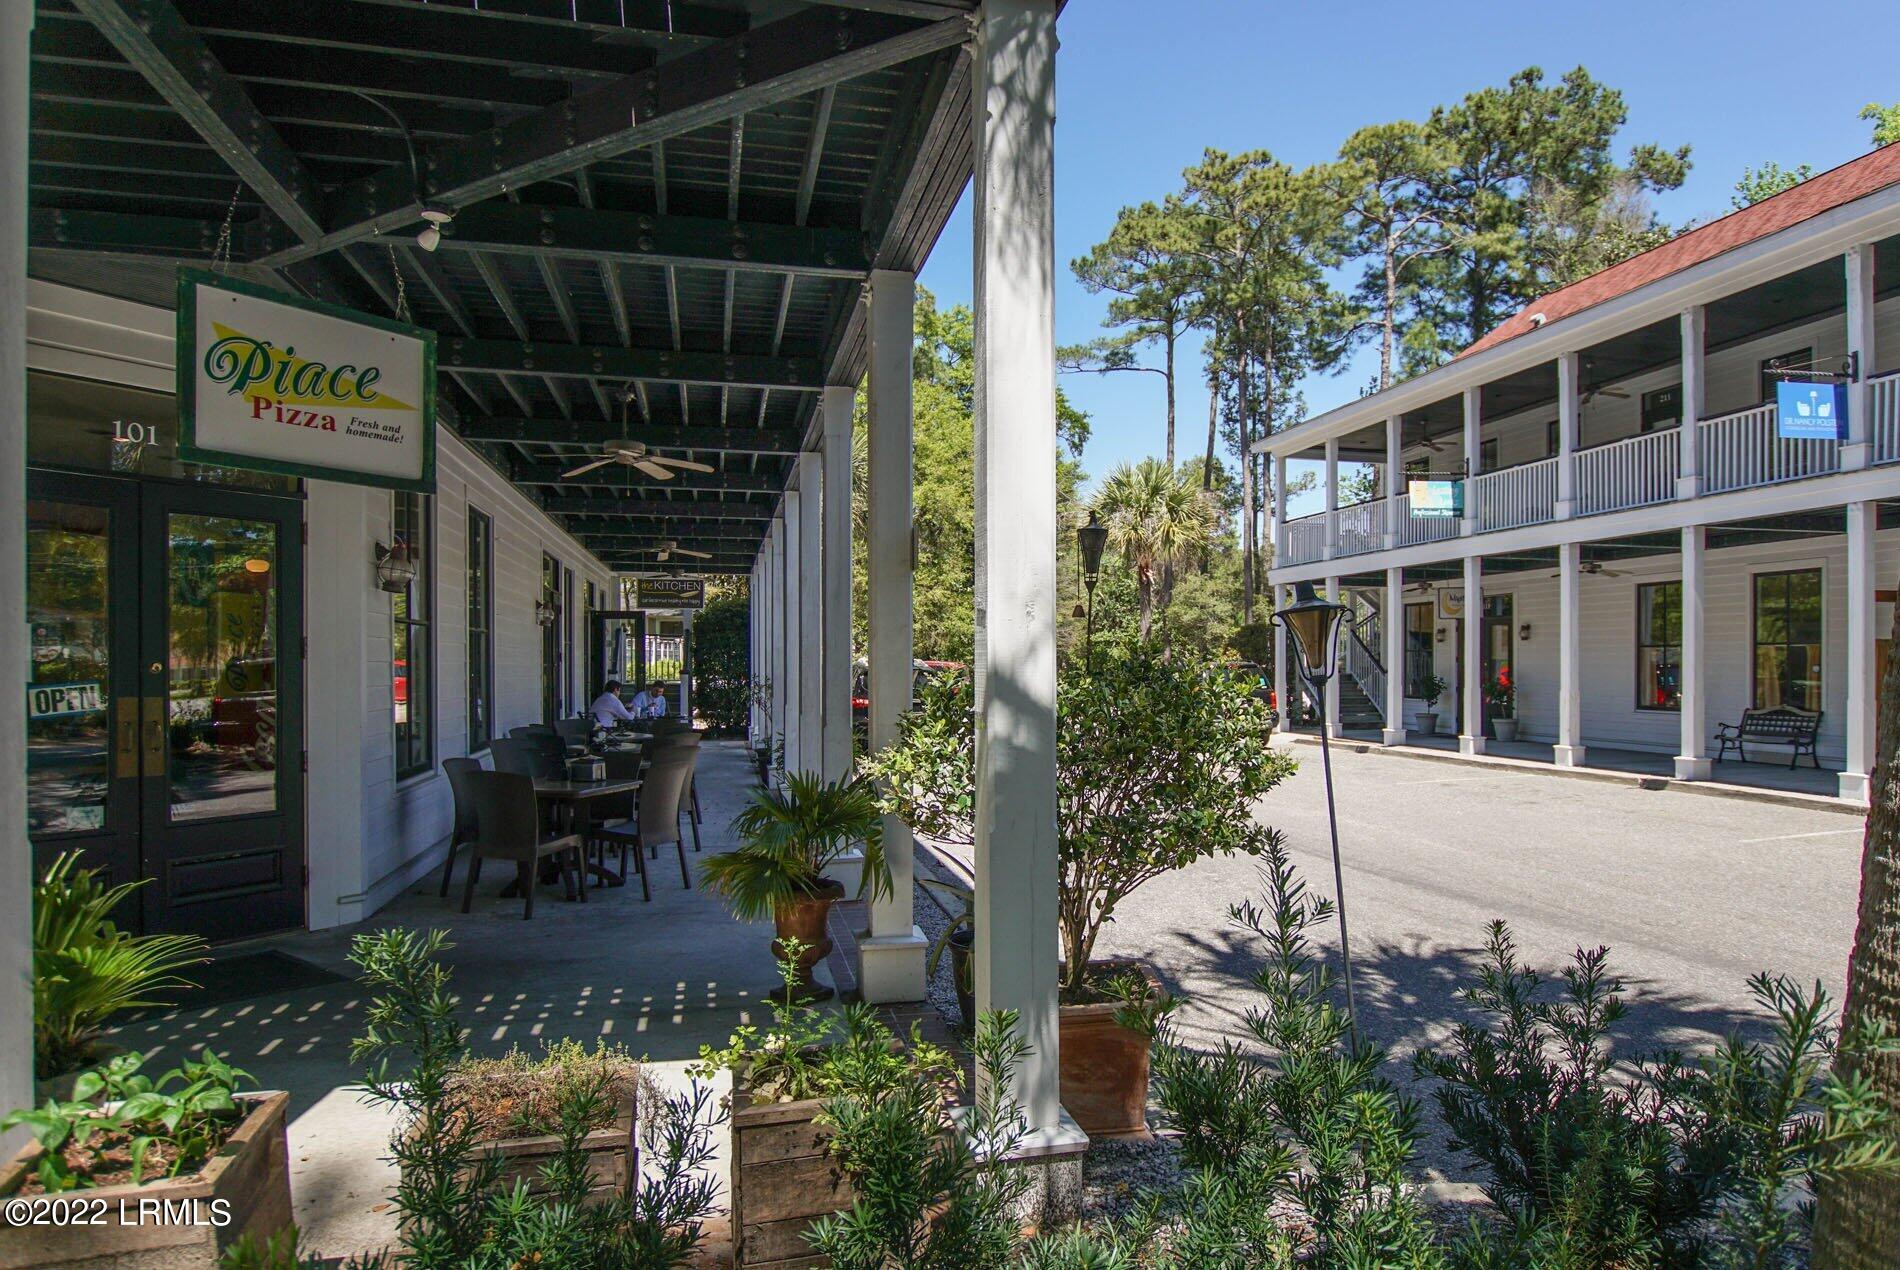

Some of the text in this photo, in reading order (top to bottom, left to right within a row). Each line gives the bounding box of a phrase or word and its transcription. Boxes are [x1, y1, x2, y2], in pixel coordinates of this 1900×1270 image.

[204, 336, 380, 402] Piace
[250, 395, 337, 432] Pizza
[112, 420, 160, 446] 101
[345, 425, 405, 444] homemade!
[350, 416, 401, 434] Fresh and
[654, 581, 701, 590] KITCHEN
